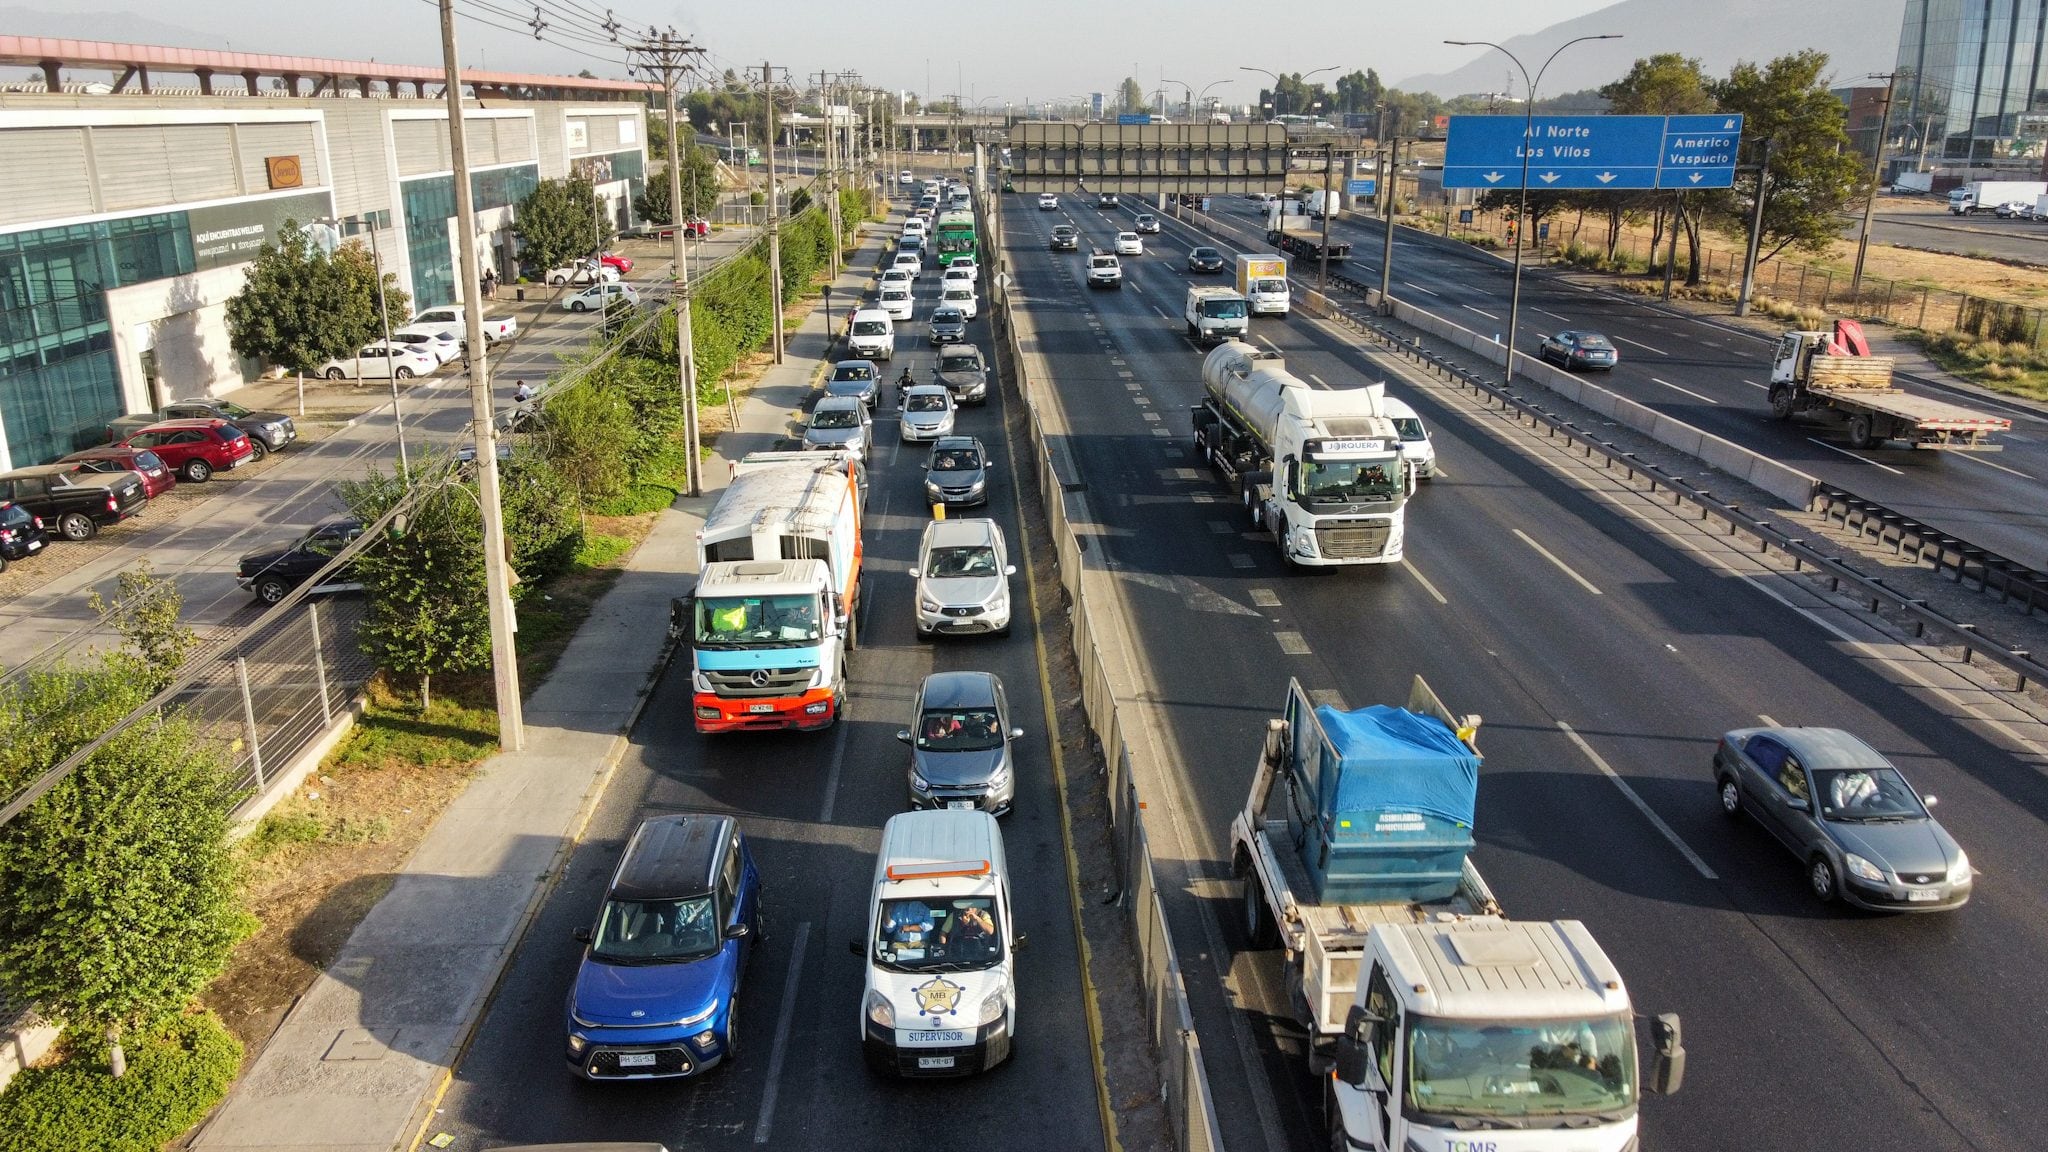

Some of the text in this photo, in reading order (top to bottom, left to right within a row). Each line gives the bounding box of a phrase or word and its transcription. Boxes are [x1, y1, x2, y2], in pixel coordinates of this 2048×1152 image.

[1523, 126, 1590, 138] Al Norte
[1674, 137, 1730, 149] Américo
[1516, 146, 1591, 158] Los Vilos
[1670, 153, 1729, 166] Vespucio
[196, 224, 265, 244] AQUÍ ENCUENTRAS WELLNESS
[1328, 442, 1379, 450] JORQUERA
[908, 1031, 963, 1041] SUPERVISOR
